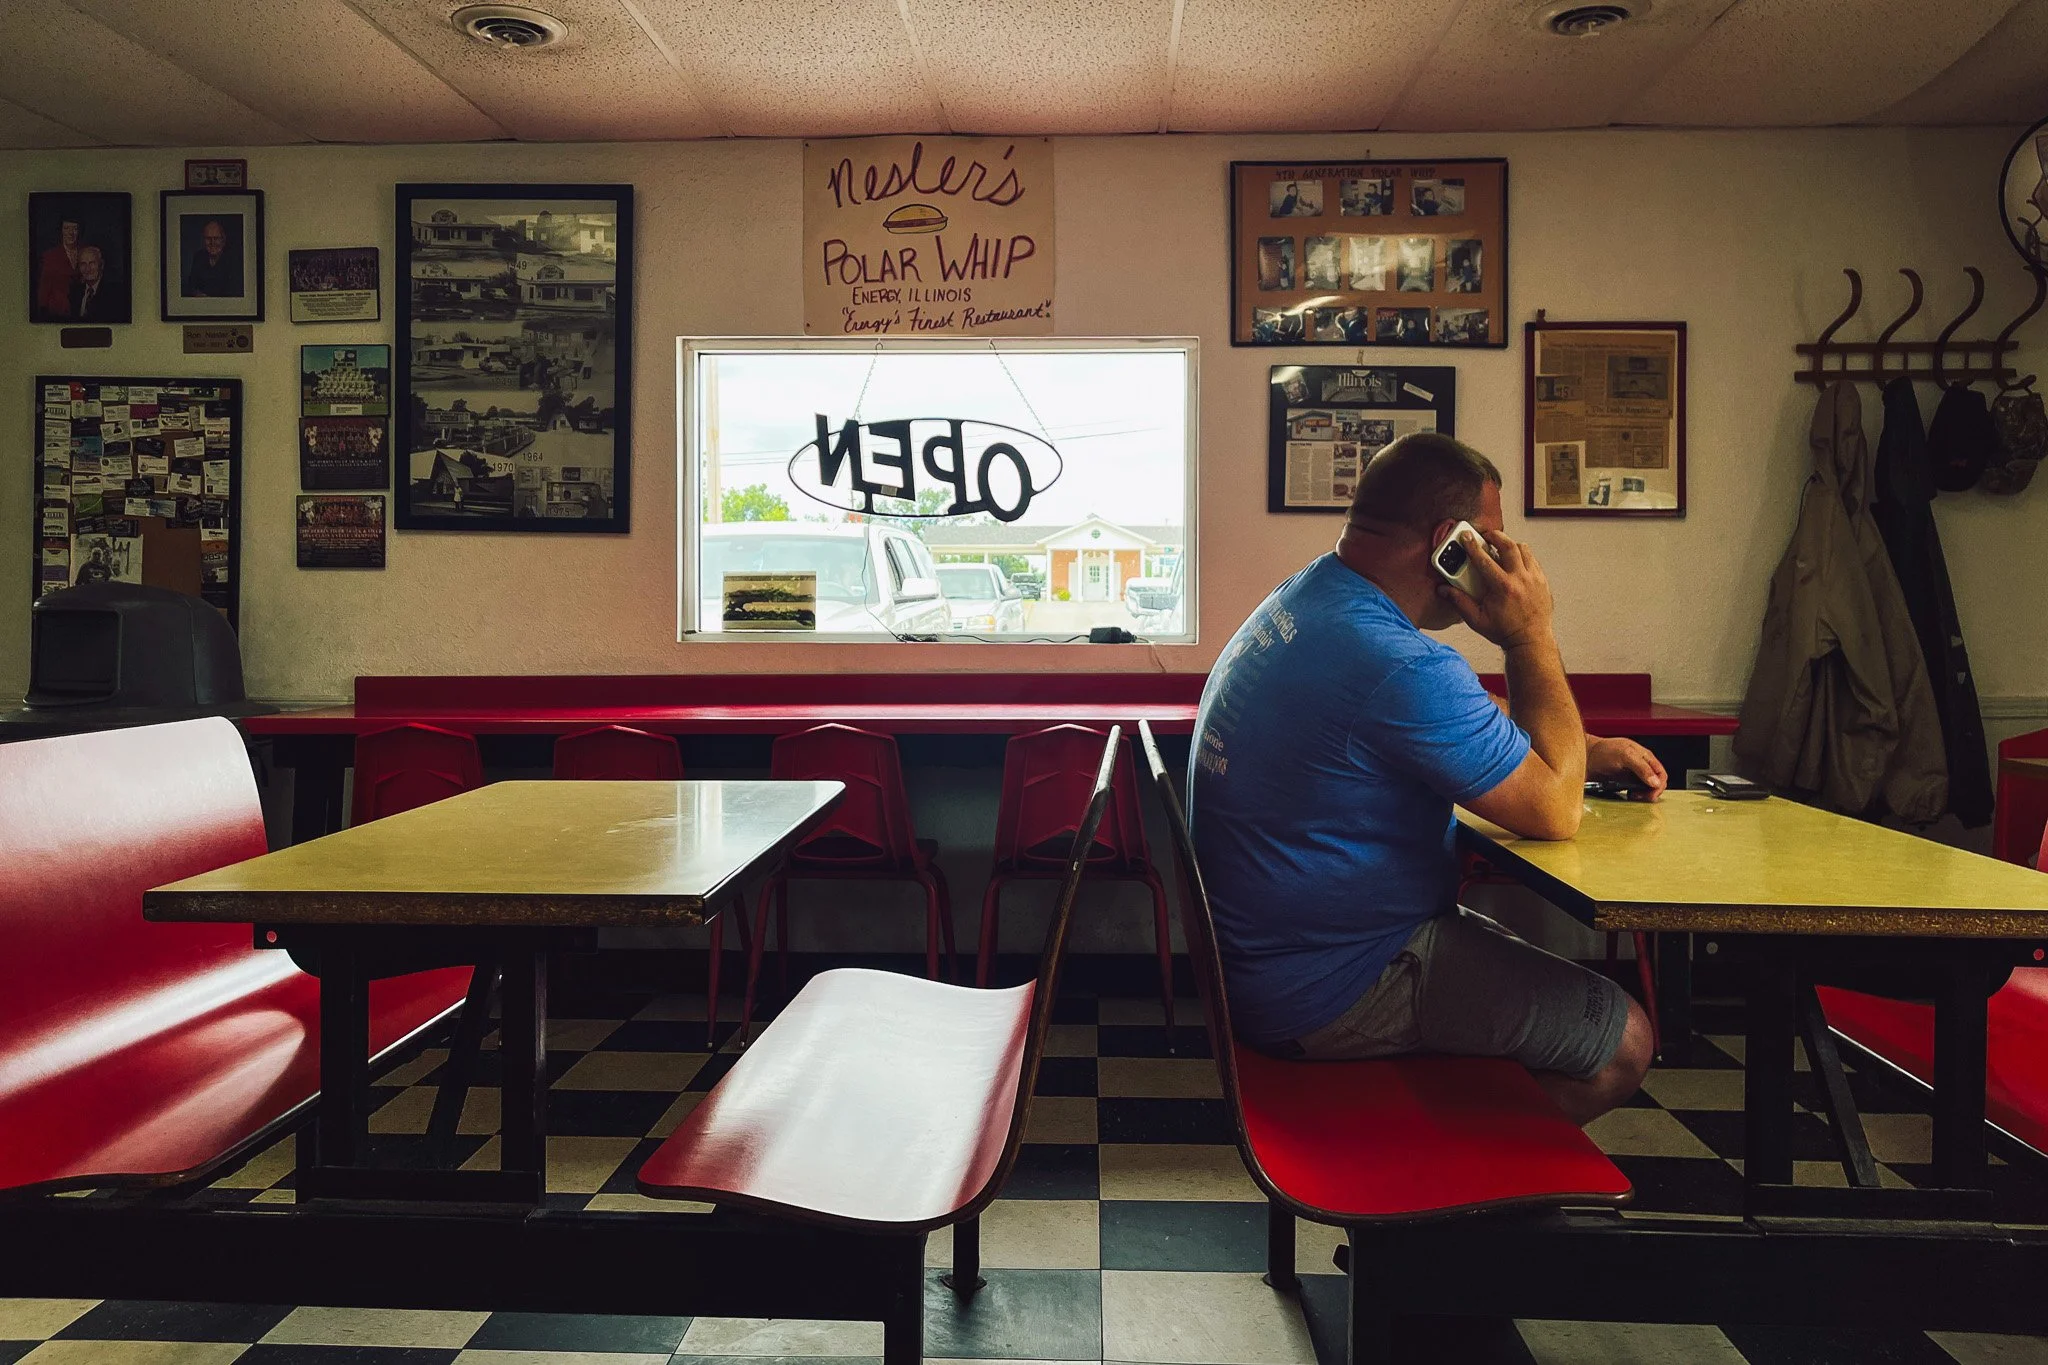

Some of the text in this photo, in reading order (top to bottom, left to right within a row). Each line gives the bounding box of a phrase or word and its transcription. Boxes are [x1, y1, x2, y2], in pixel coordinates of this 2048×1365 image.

[1303, 168, 1363, 179] GENERATION
[823, 232, 1035, 286] POLAR WHIP
[852, 286, 972, 305] ENERGY, ILLINOIS
[905, 307, 954, 331] Finest
[1338, 372, 1382, 387] Illinois
[522, 453, 543, 461] 1964
[493, 463, 513, 472] 1970
